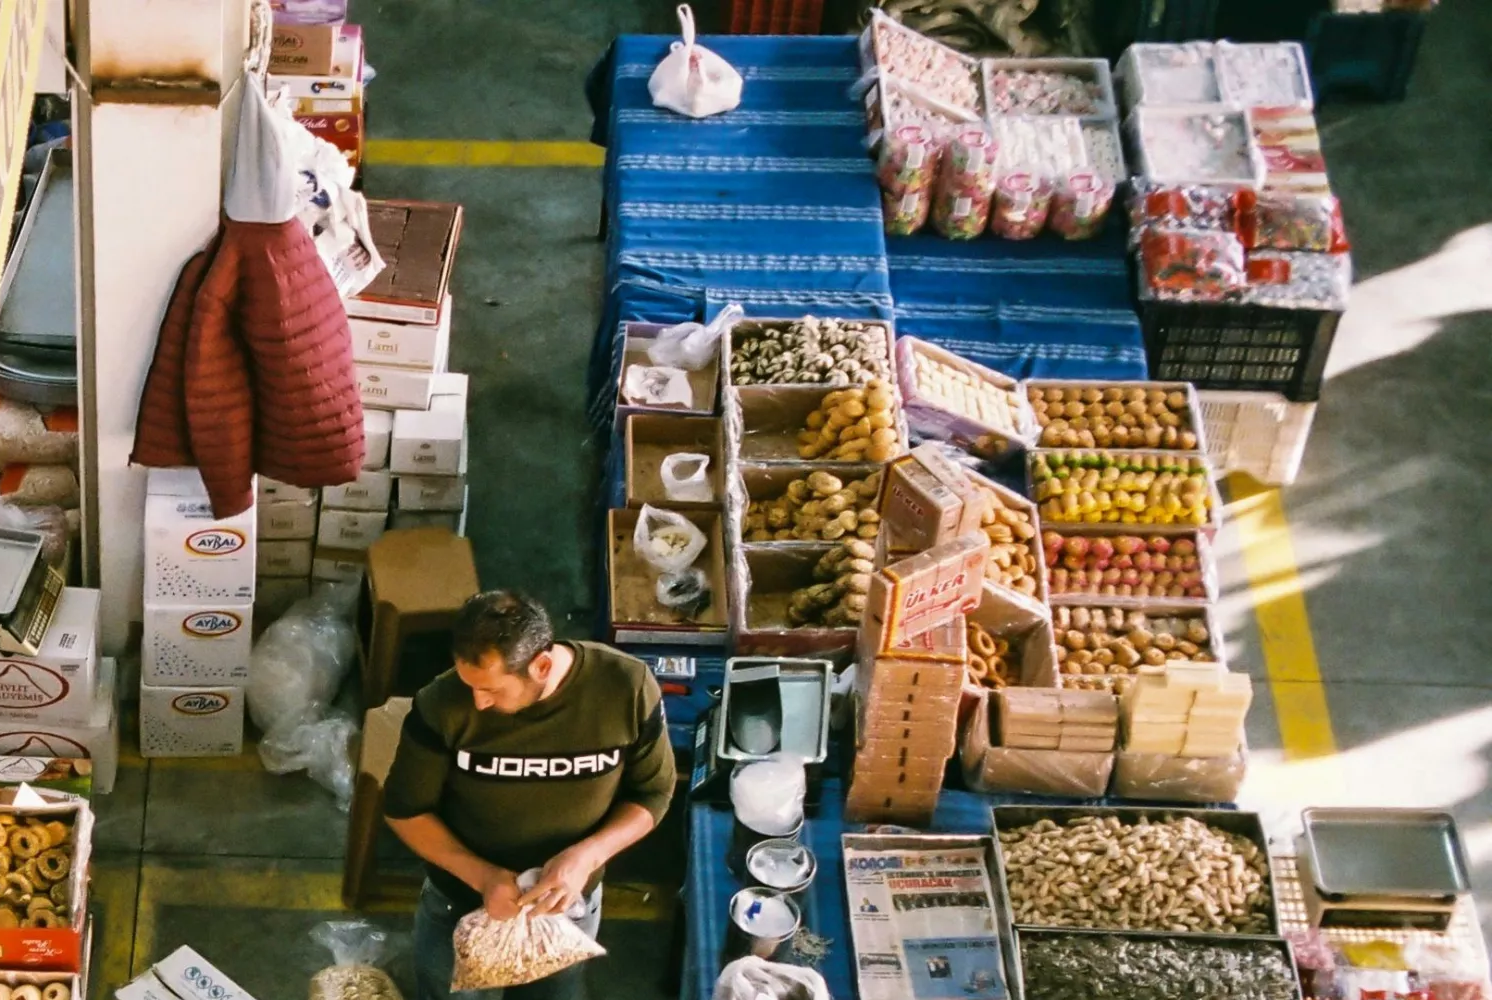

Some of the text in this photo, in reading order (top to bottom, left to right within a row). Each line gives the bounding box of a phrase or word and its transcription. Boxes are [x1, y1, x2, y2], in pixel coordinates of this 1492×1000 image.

[367, 339, 399, 354] Lami
[196, 534, 237, 550] AYBAL
[905, 572, 968, 610] ÜLKER
[475, 749, 620, 777] JORDAN
